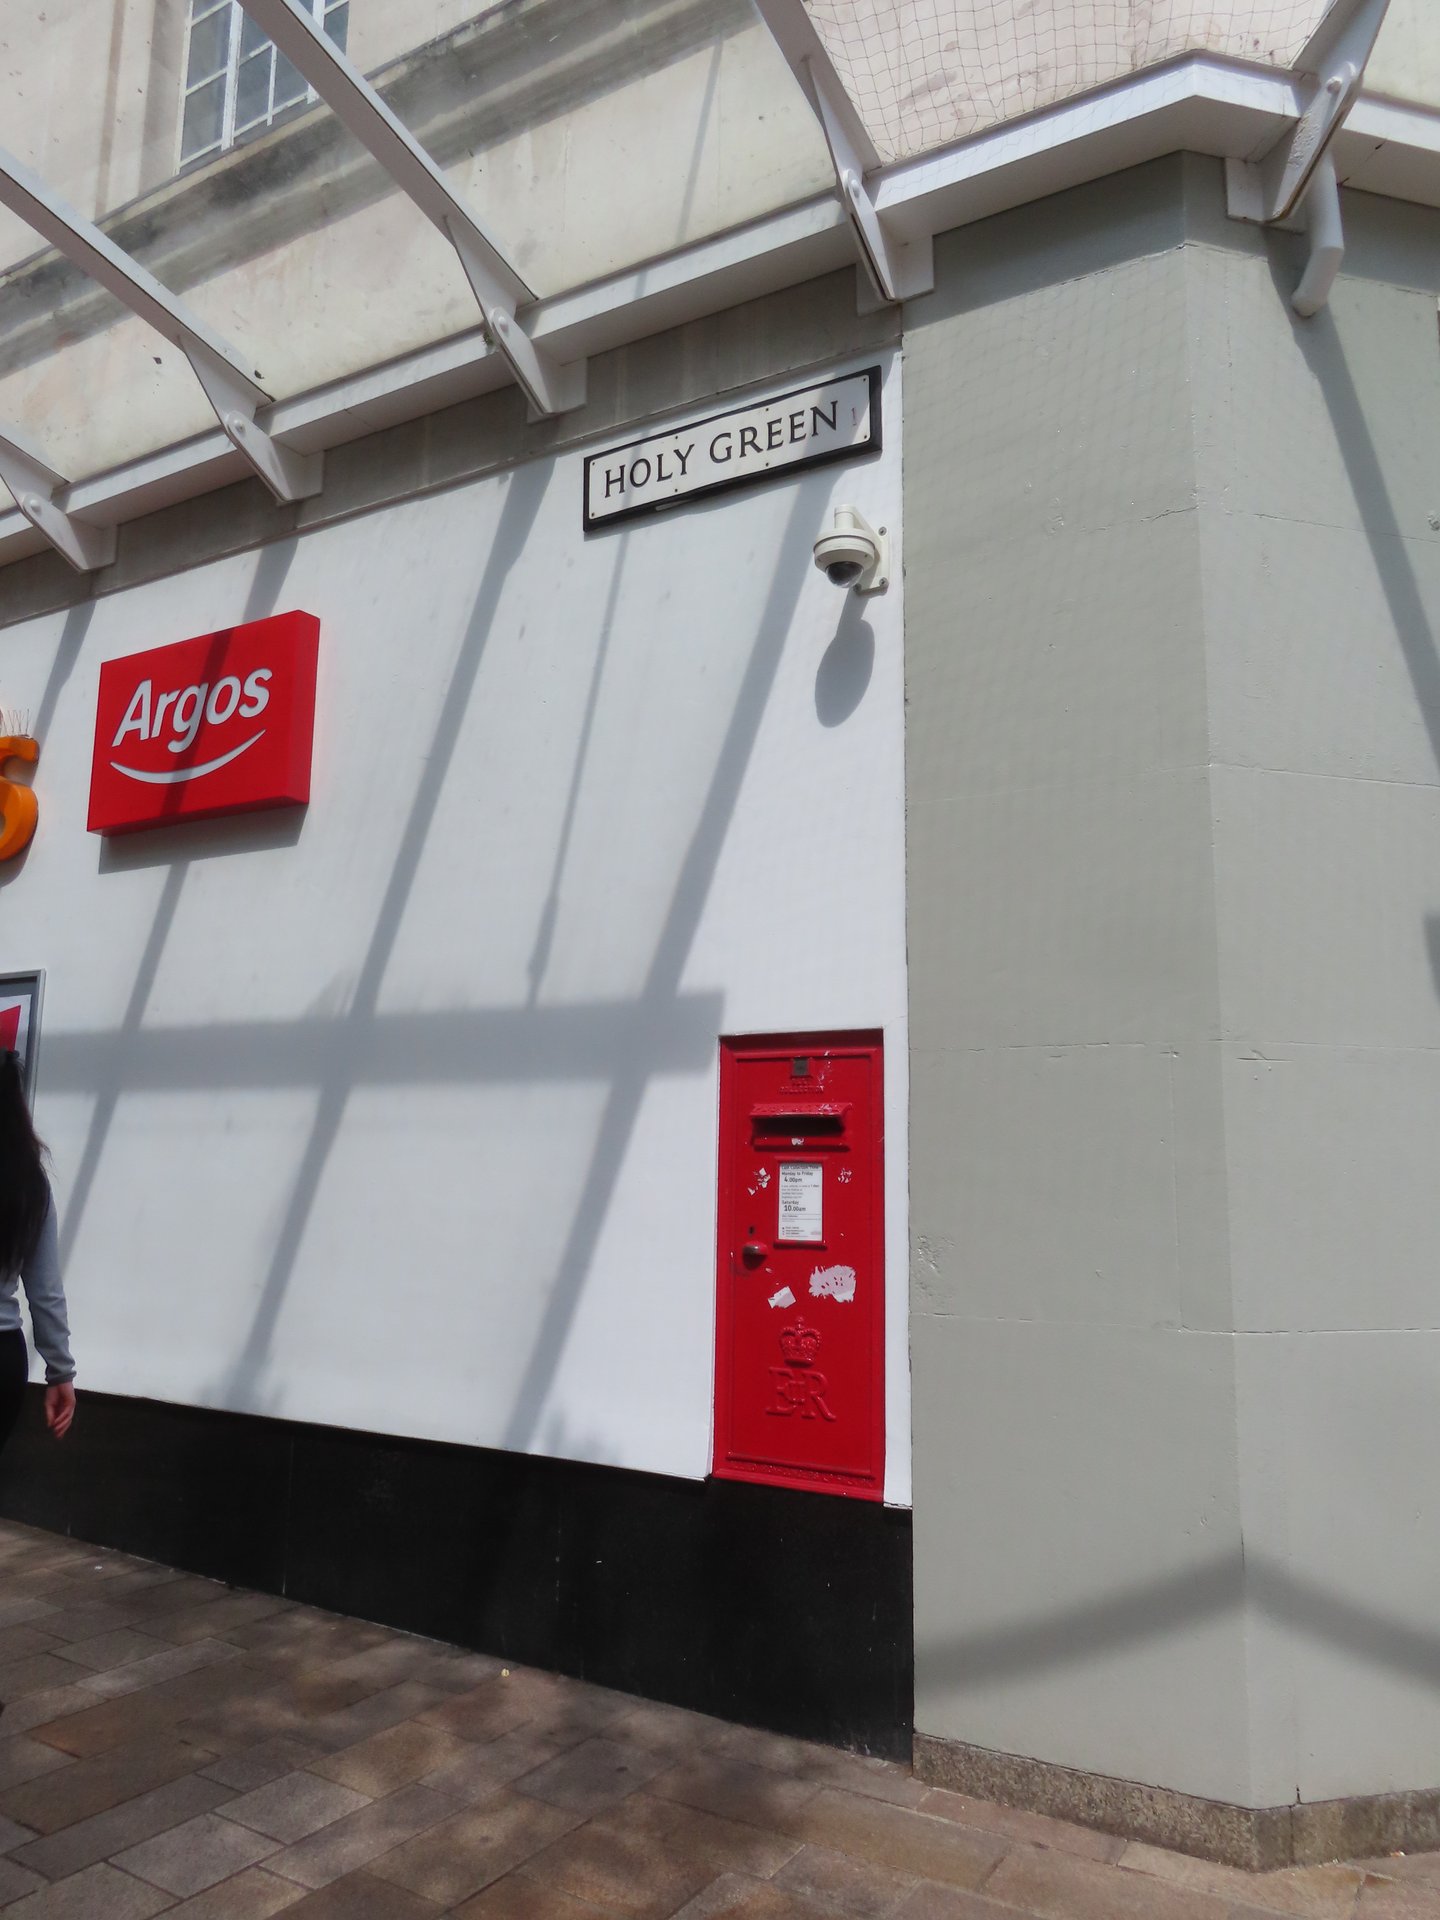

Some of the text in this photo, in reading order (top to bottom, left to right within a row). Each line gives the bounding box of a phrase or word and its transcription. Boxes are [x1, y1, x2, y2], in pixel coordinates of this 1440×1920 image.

[604, 444, 695, 498] HOLY
[709, 400, 839, 464] GREEN
[111, 667, 273, 754] Argos
